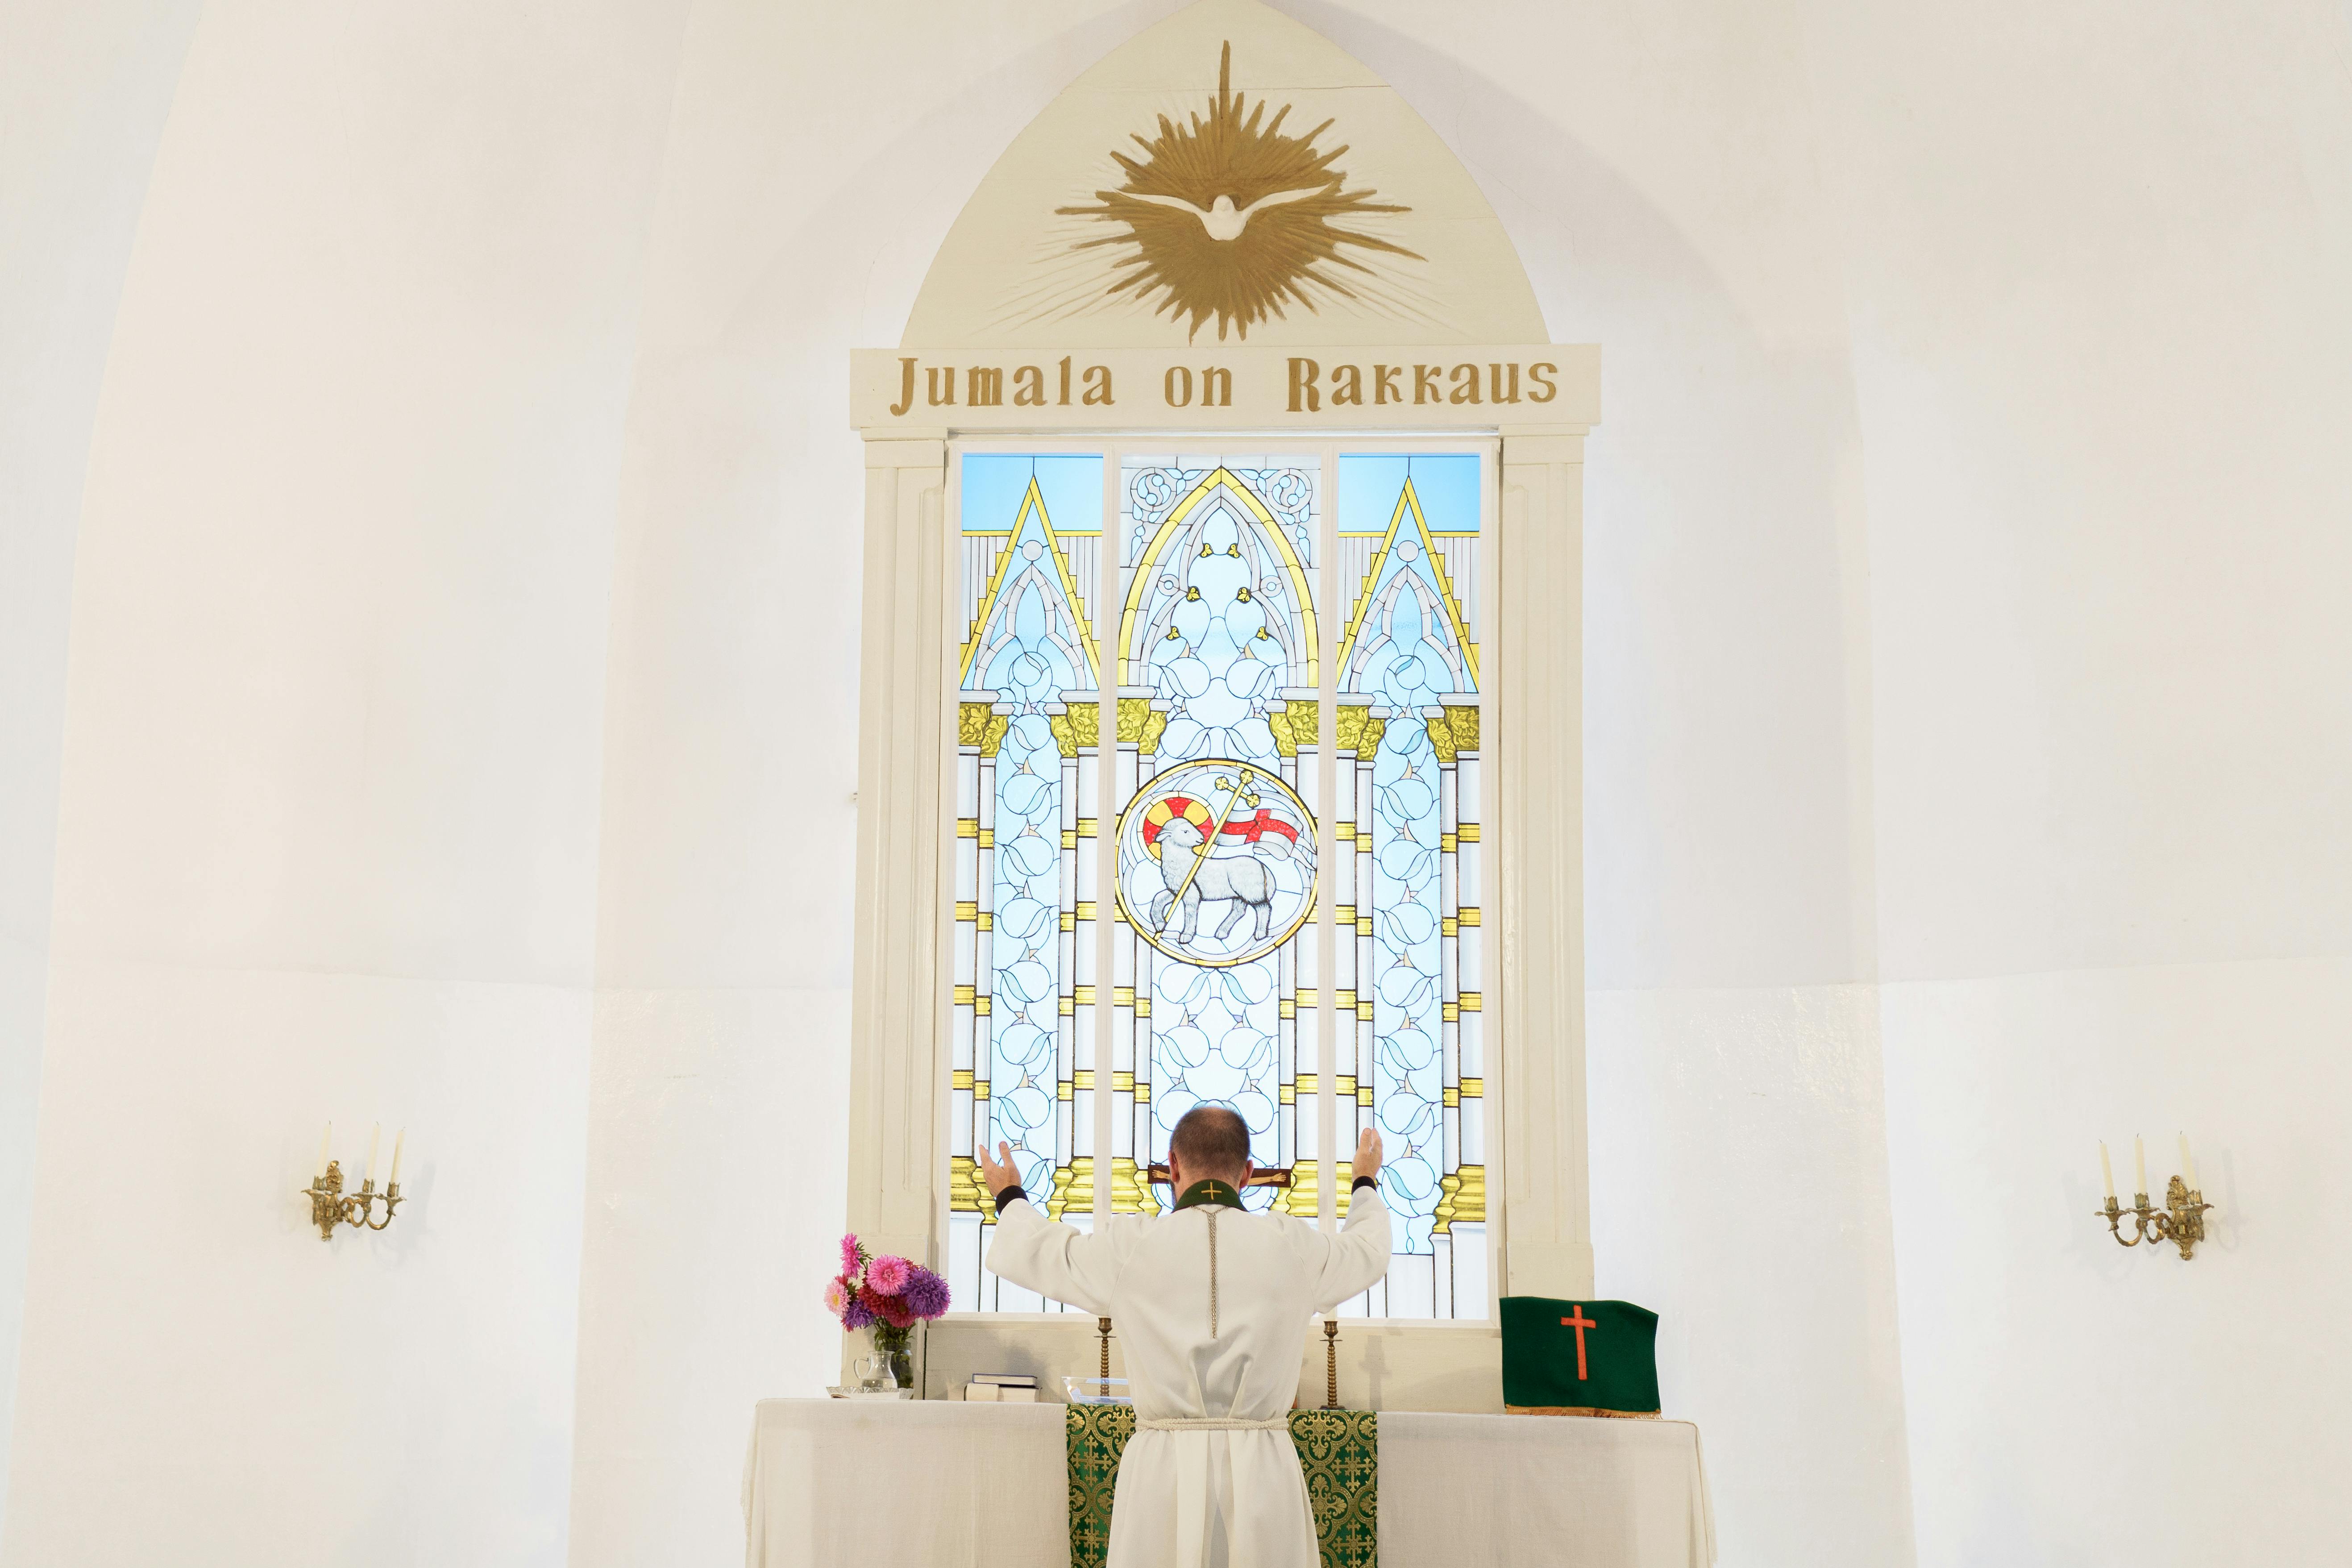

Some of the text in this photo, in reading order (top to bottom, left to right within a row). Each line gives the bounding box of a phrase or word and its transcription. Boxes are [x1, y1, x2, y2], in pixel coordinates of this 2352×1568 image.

[889, 357, 1558, 416] Jumala on Rakkaus
